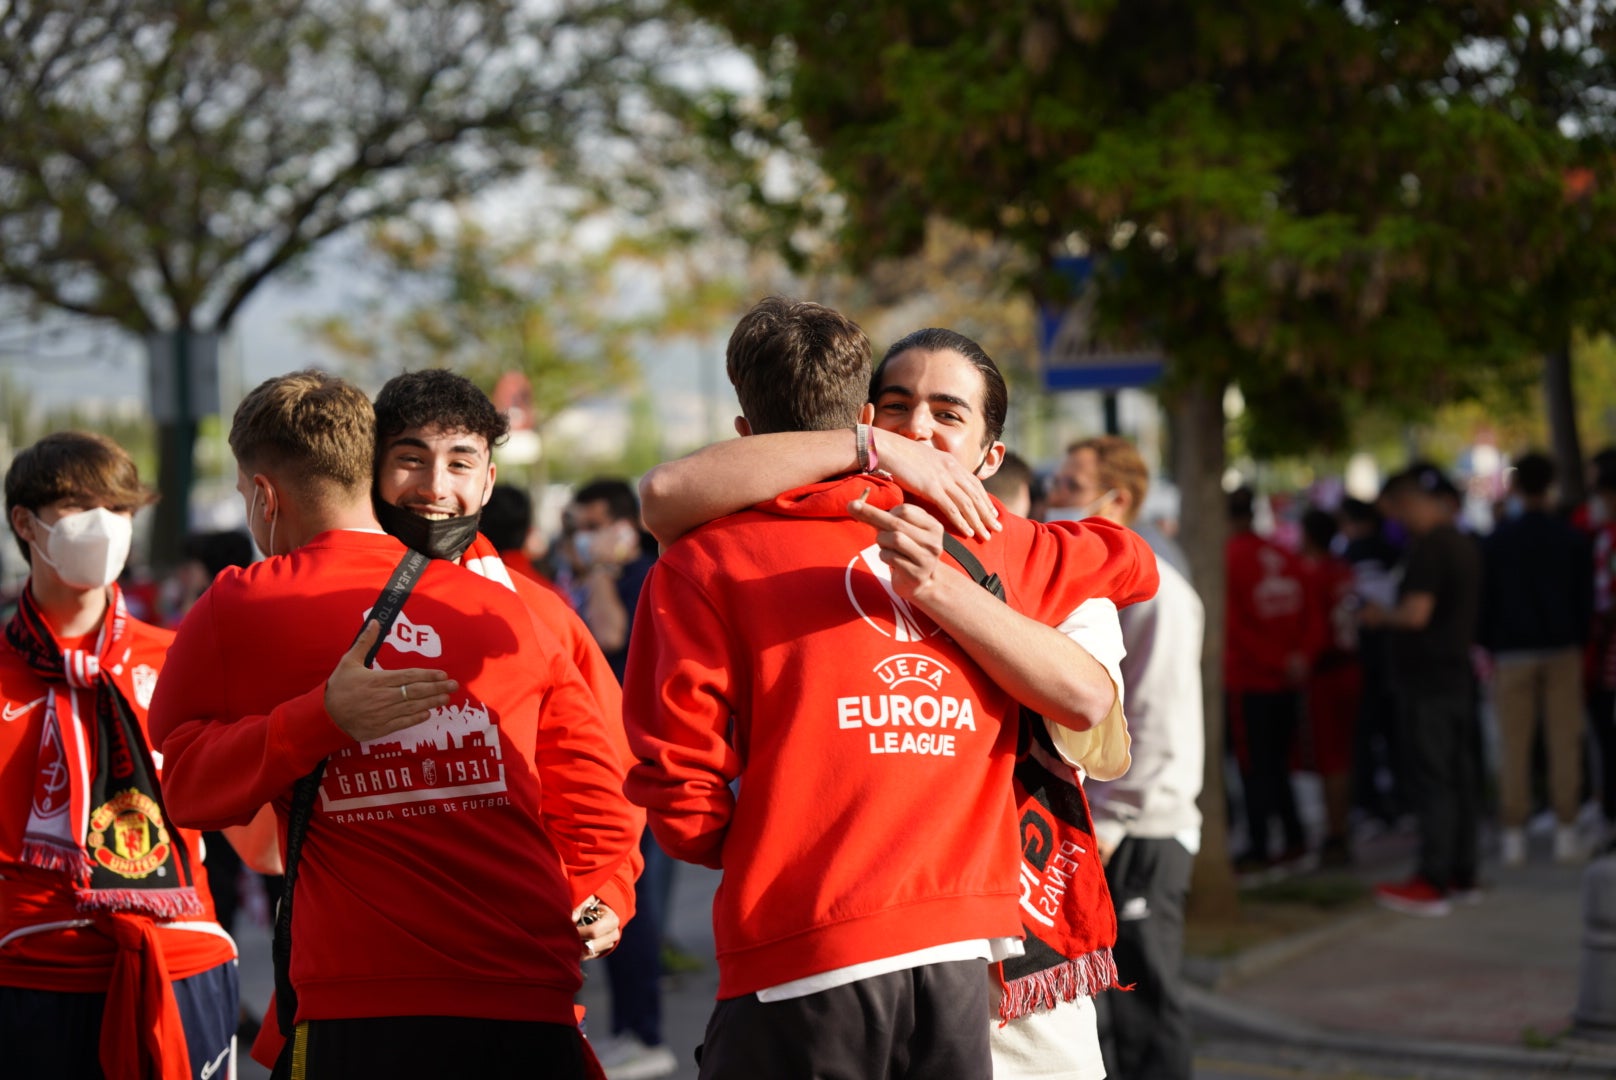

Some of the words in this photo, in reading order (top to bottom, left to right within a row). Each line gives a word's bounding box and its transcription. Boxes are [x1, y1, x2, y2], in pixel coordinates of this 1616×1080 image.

[387, 571, 412, 604] JEANS
[388, 622, 429, 647] CF
[877, 659, 944, 687] UEFA
[837, 694, 976, 732] EUROPA
[869, 731, 956, 757] LEAGUE
[445, 758, 491, 784] 1931
[402, 803, 437, 818] CLUB
[443, 802, 457, 813] DE
[462, 796, 511, 811] FUTBOL
[110, 855, 158, 873] UNITED
